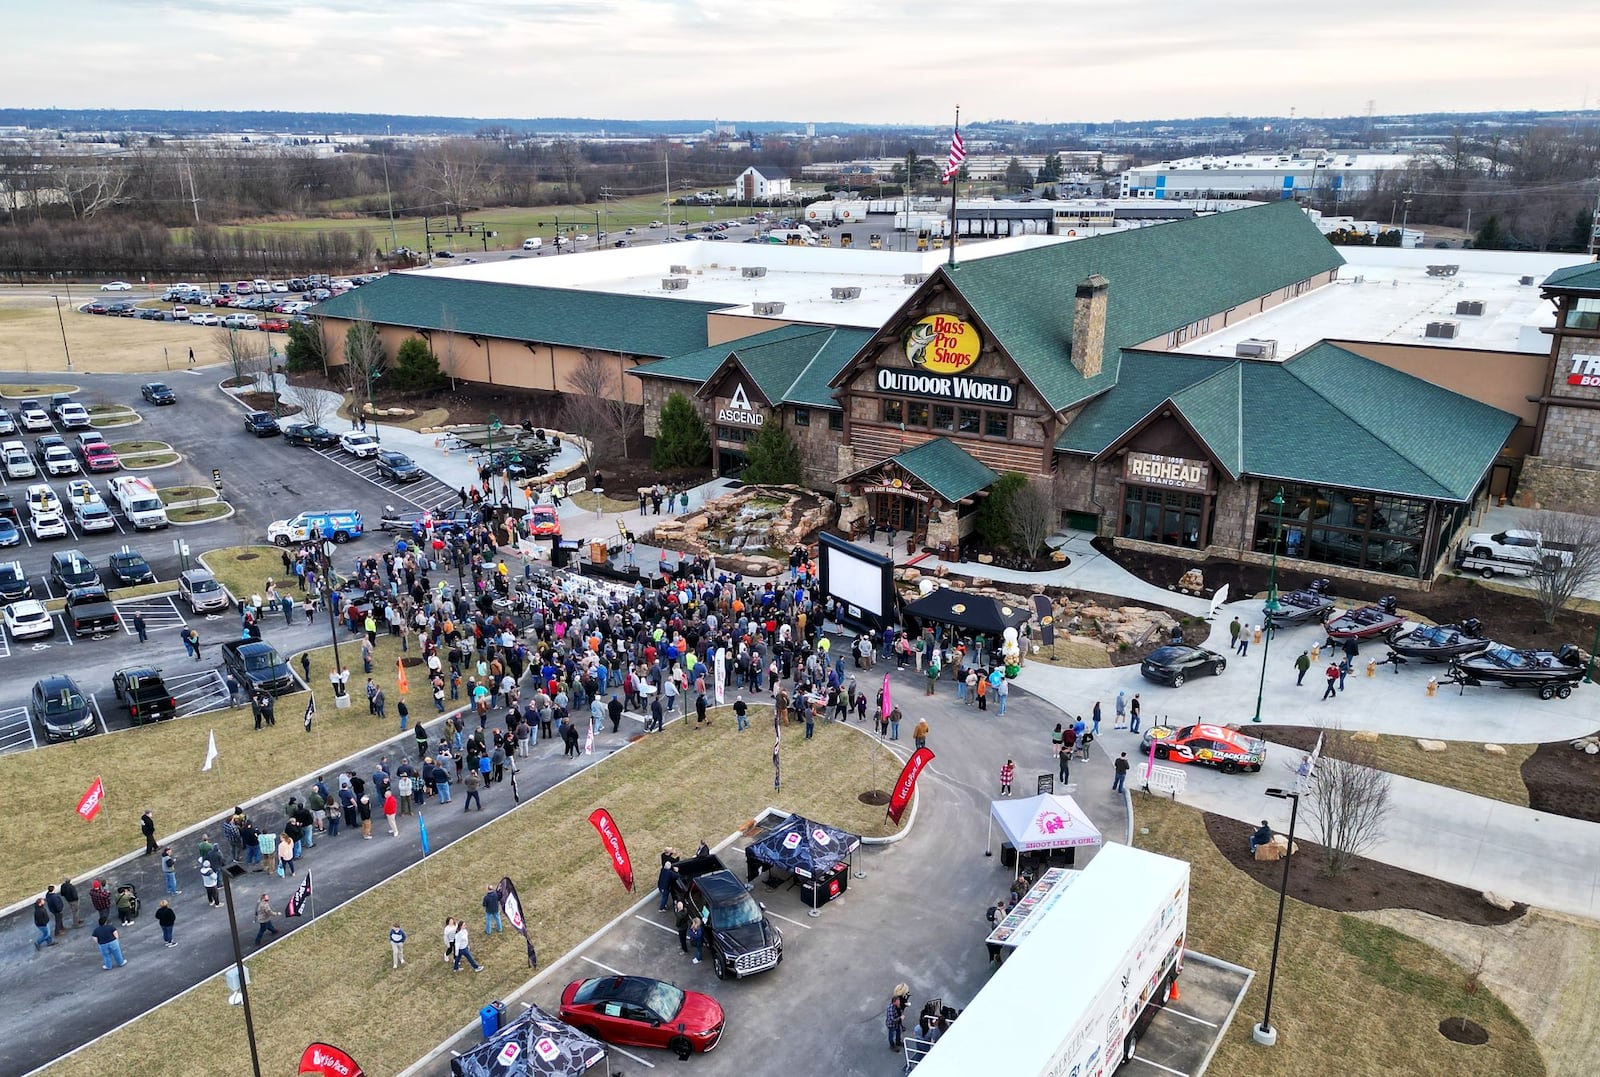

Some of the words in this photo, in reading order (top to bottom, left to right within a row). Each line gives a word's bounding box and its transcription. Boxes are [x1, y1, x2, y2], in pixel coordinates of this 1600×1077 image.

[934, 317, 965, 335] Bass
[934, 332, 958, 349] Pro
[933, 348, 971, 367] Shops
[878, 369, 951, 396] OUTDOOR
[953, 376, 1013, 402] WORLD
[1580, 376, 1600, 387] BO
[719, 409, 764, 425] ASCEND
[1132, 459, 1201, 483] REDHEAD
[1146, 477, 1174, 486] BRAND
[1176, 745, 1194, 759] 3
[1213, 750, 1251, 761] TRACKER
